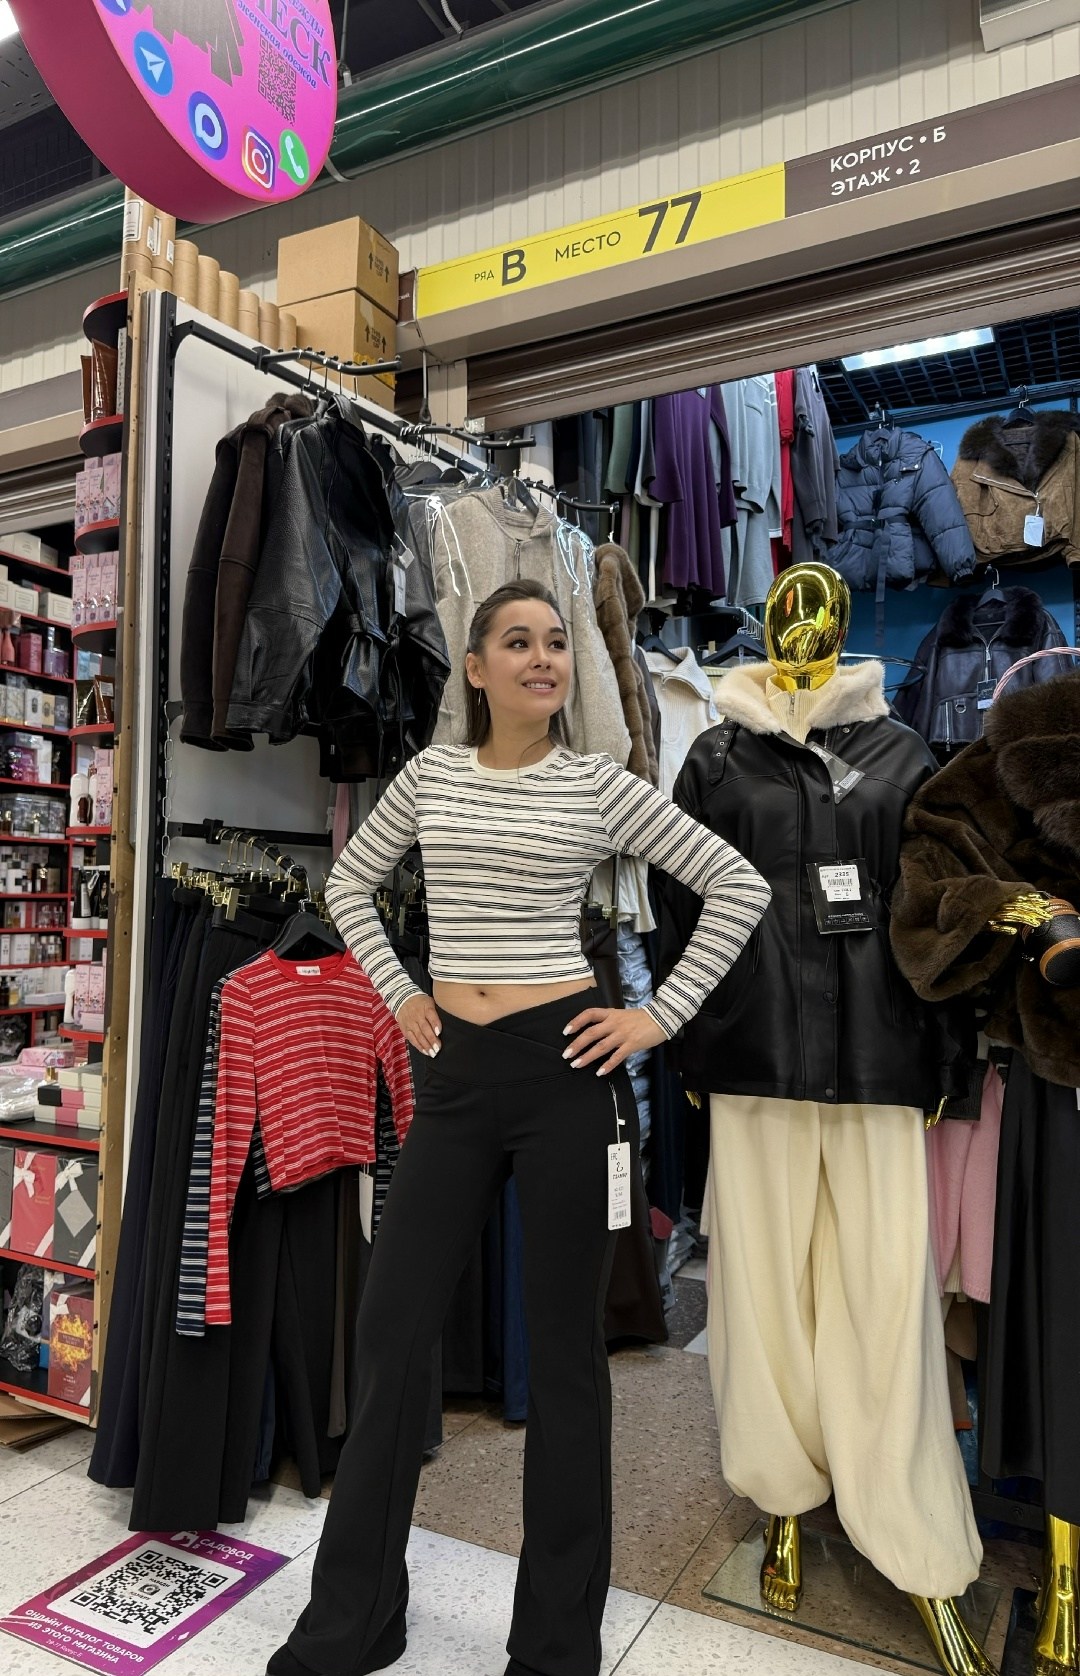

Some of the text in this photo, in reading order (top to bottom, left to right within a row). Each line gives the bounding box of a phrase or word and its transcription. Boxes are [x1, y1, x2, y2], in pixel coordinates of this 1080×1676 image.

[830, 126, 947, 173] КОРПУС Б
[831, 159, 921, 196] ЭТАЖ 2
[474, 190, 702, 287] РЯД В МЕСТО 77
[200, 1538, 255, 1561] САДОВОД
[28, 1621, 120, 1664] ИЗ ЭТОГО МАГАЗИНА
[61, 1624, 103, 1644] КАТАЛОГ
[102, 1641, 145, 1663] ТОВАРОВ
